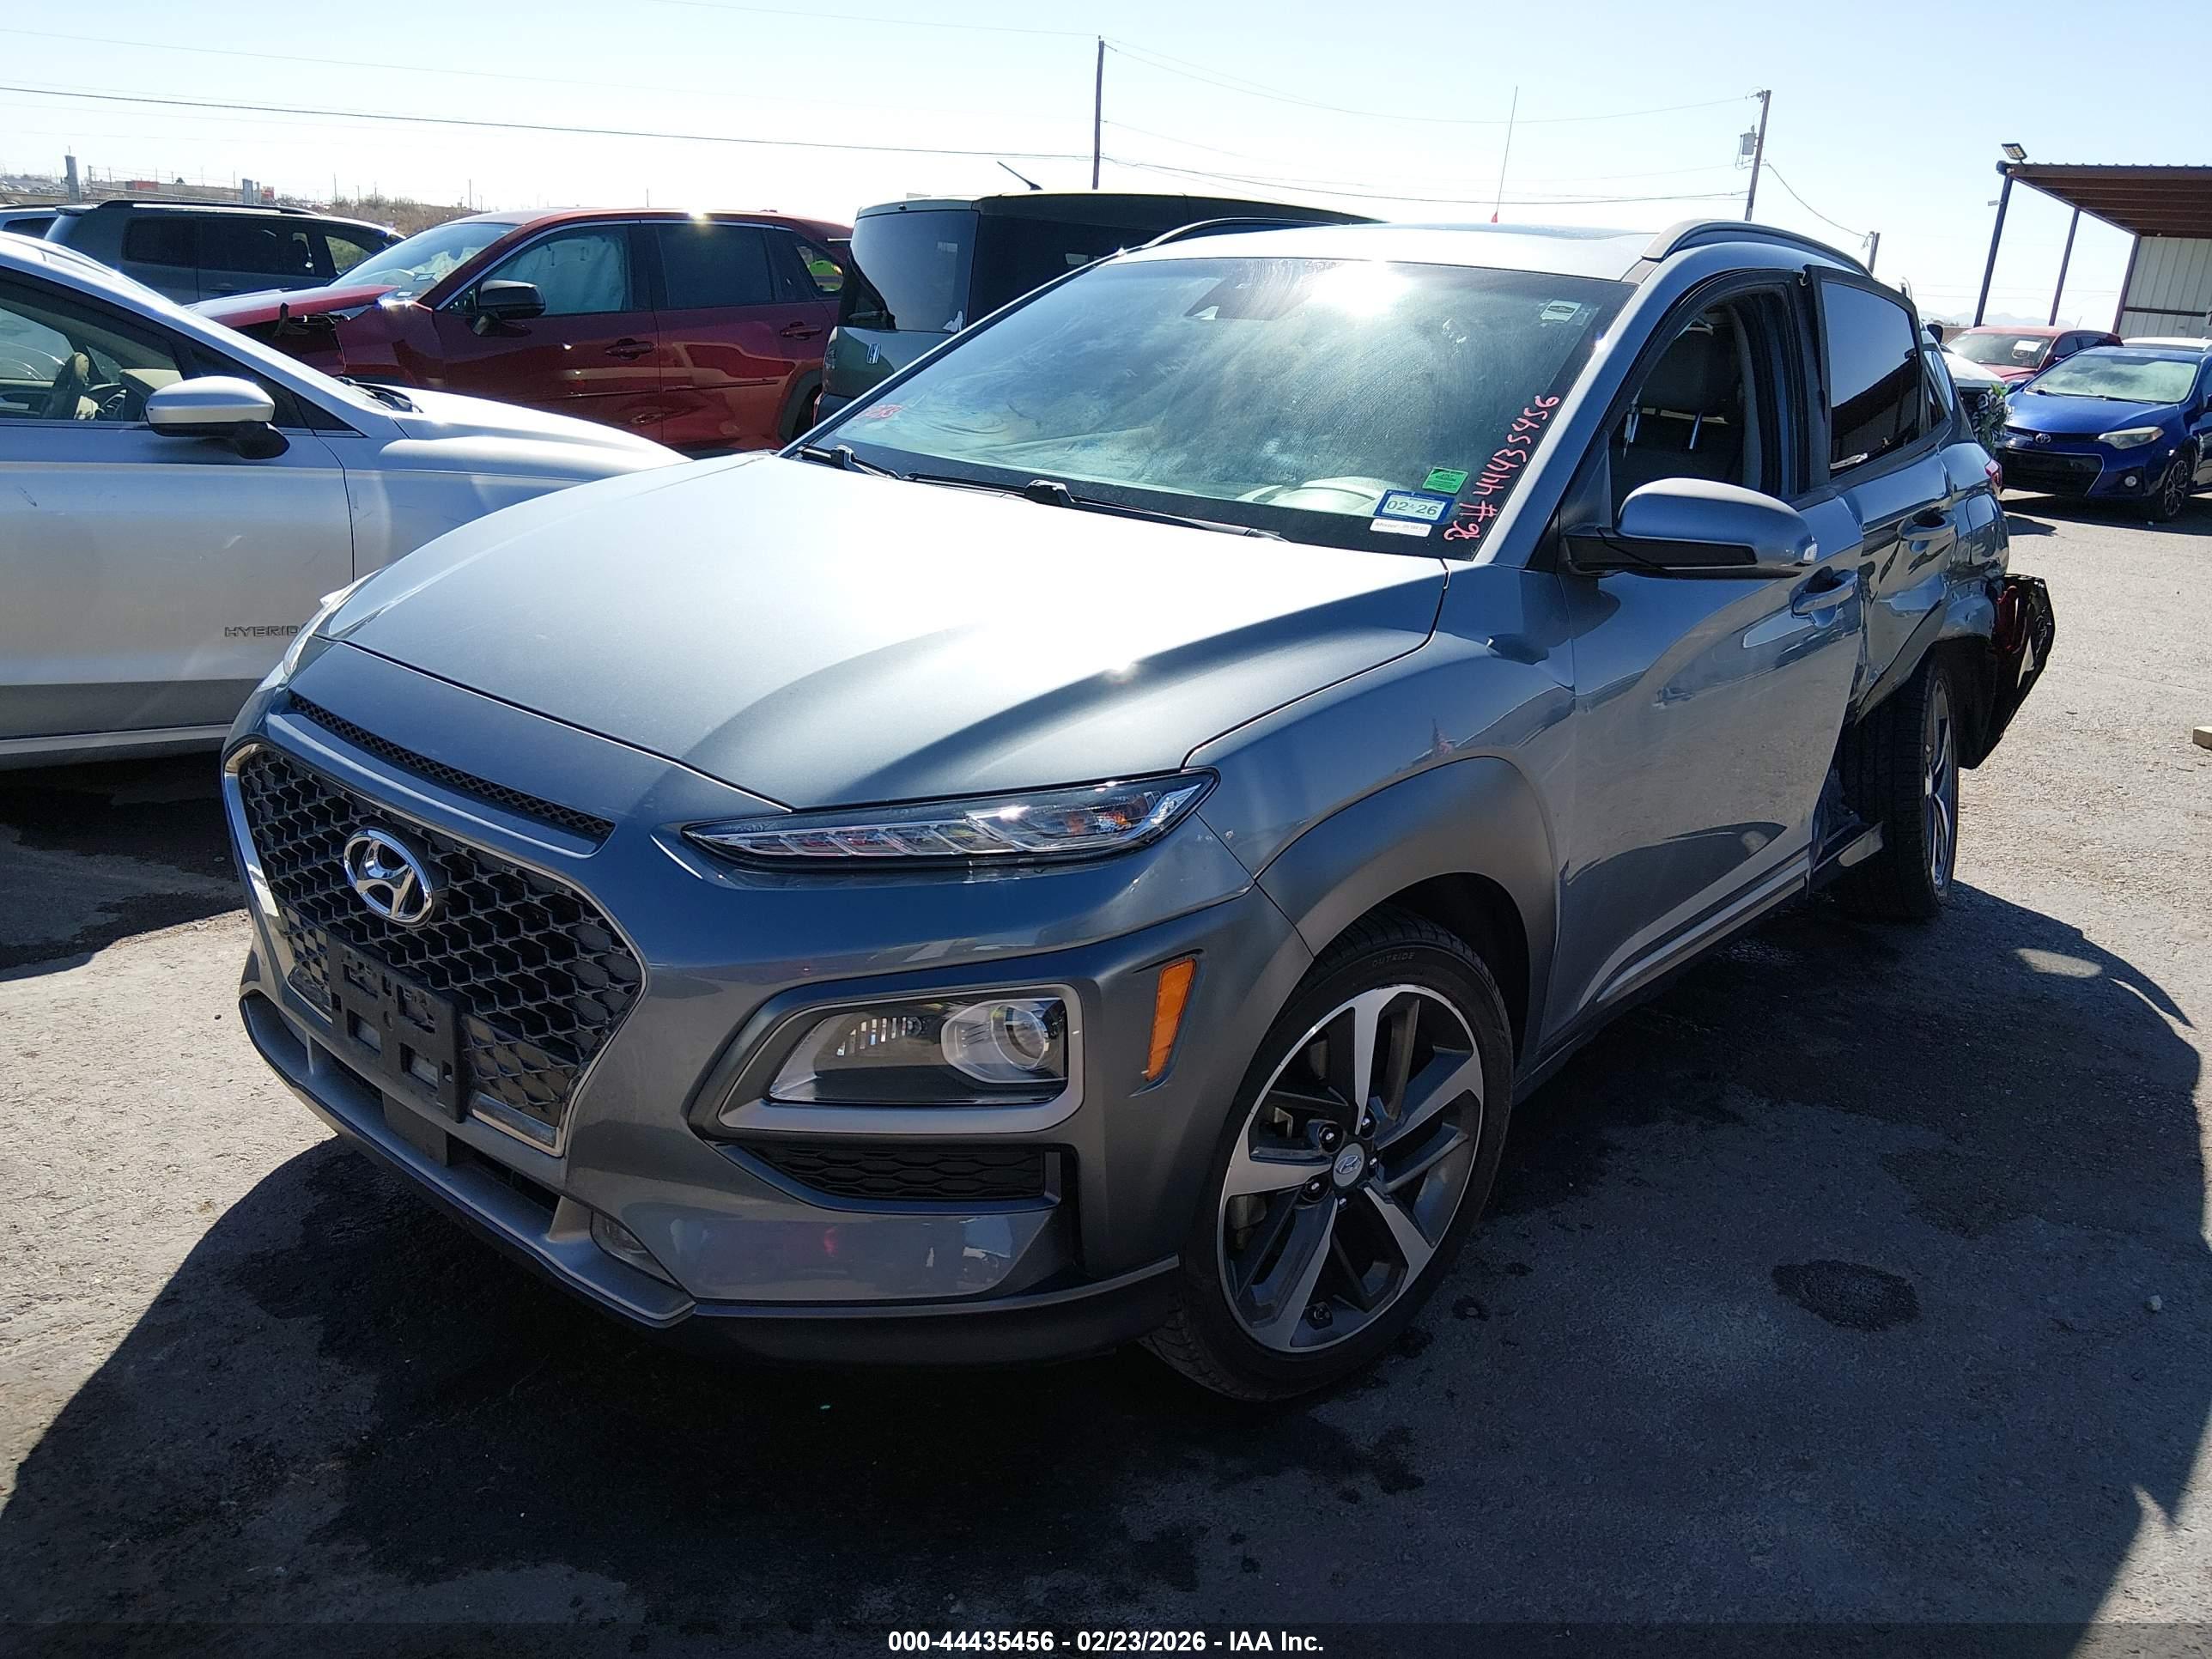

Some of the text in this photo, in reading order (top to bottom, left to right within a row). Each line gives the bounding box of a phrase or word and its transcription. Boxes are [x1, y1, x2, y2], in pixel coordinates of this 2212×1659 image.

[1386, 500, 1409, 511] 02
[1415, 504, 1438, 516] 26
[224, 625, 301, 636] HYBRID
[1373, 951, 1415, 969] OUTSIDE
